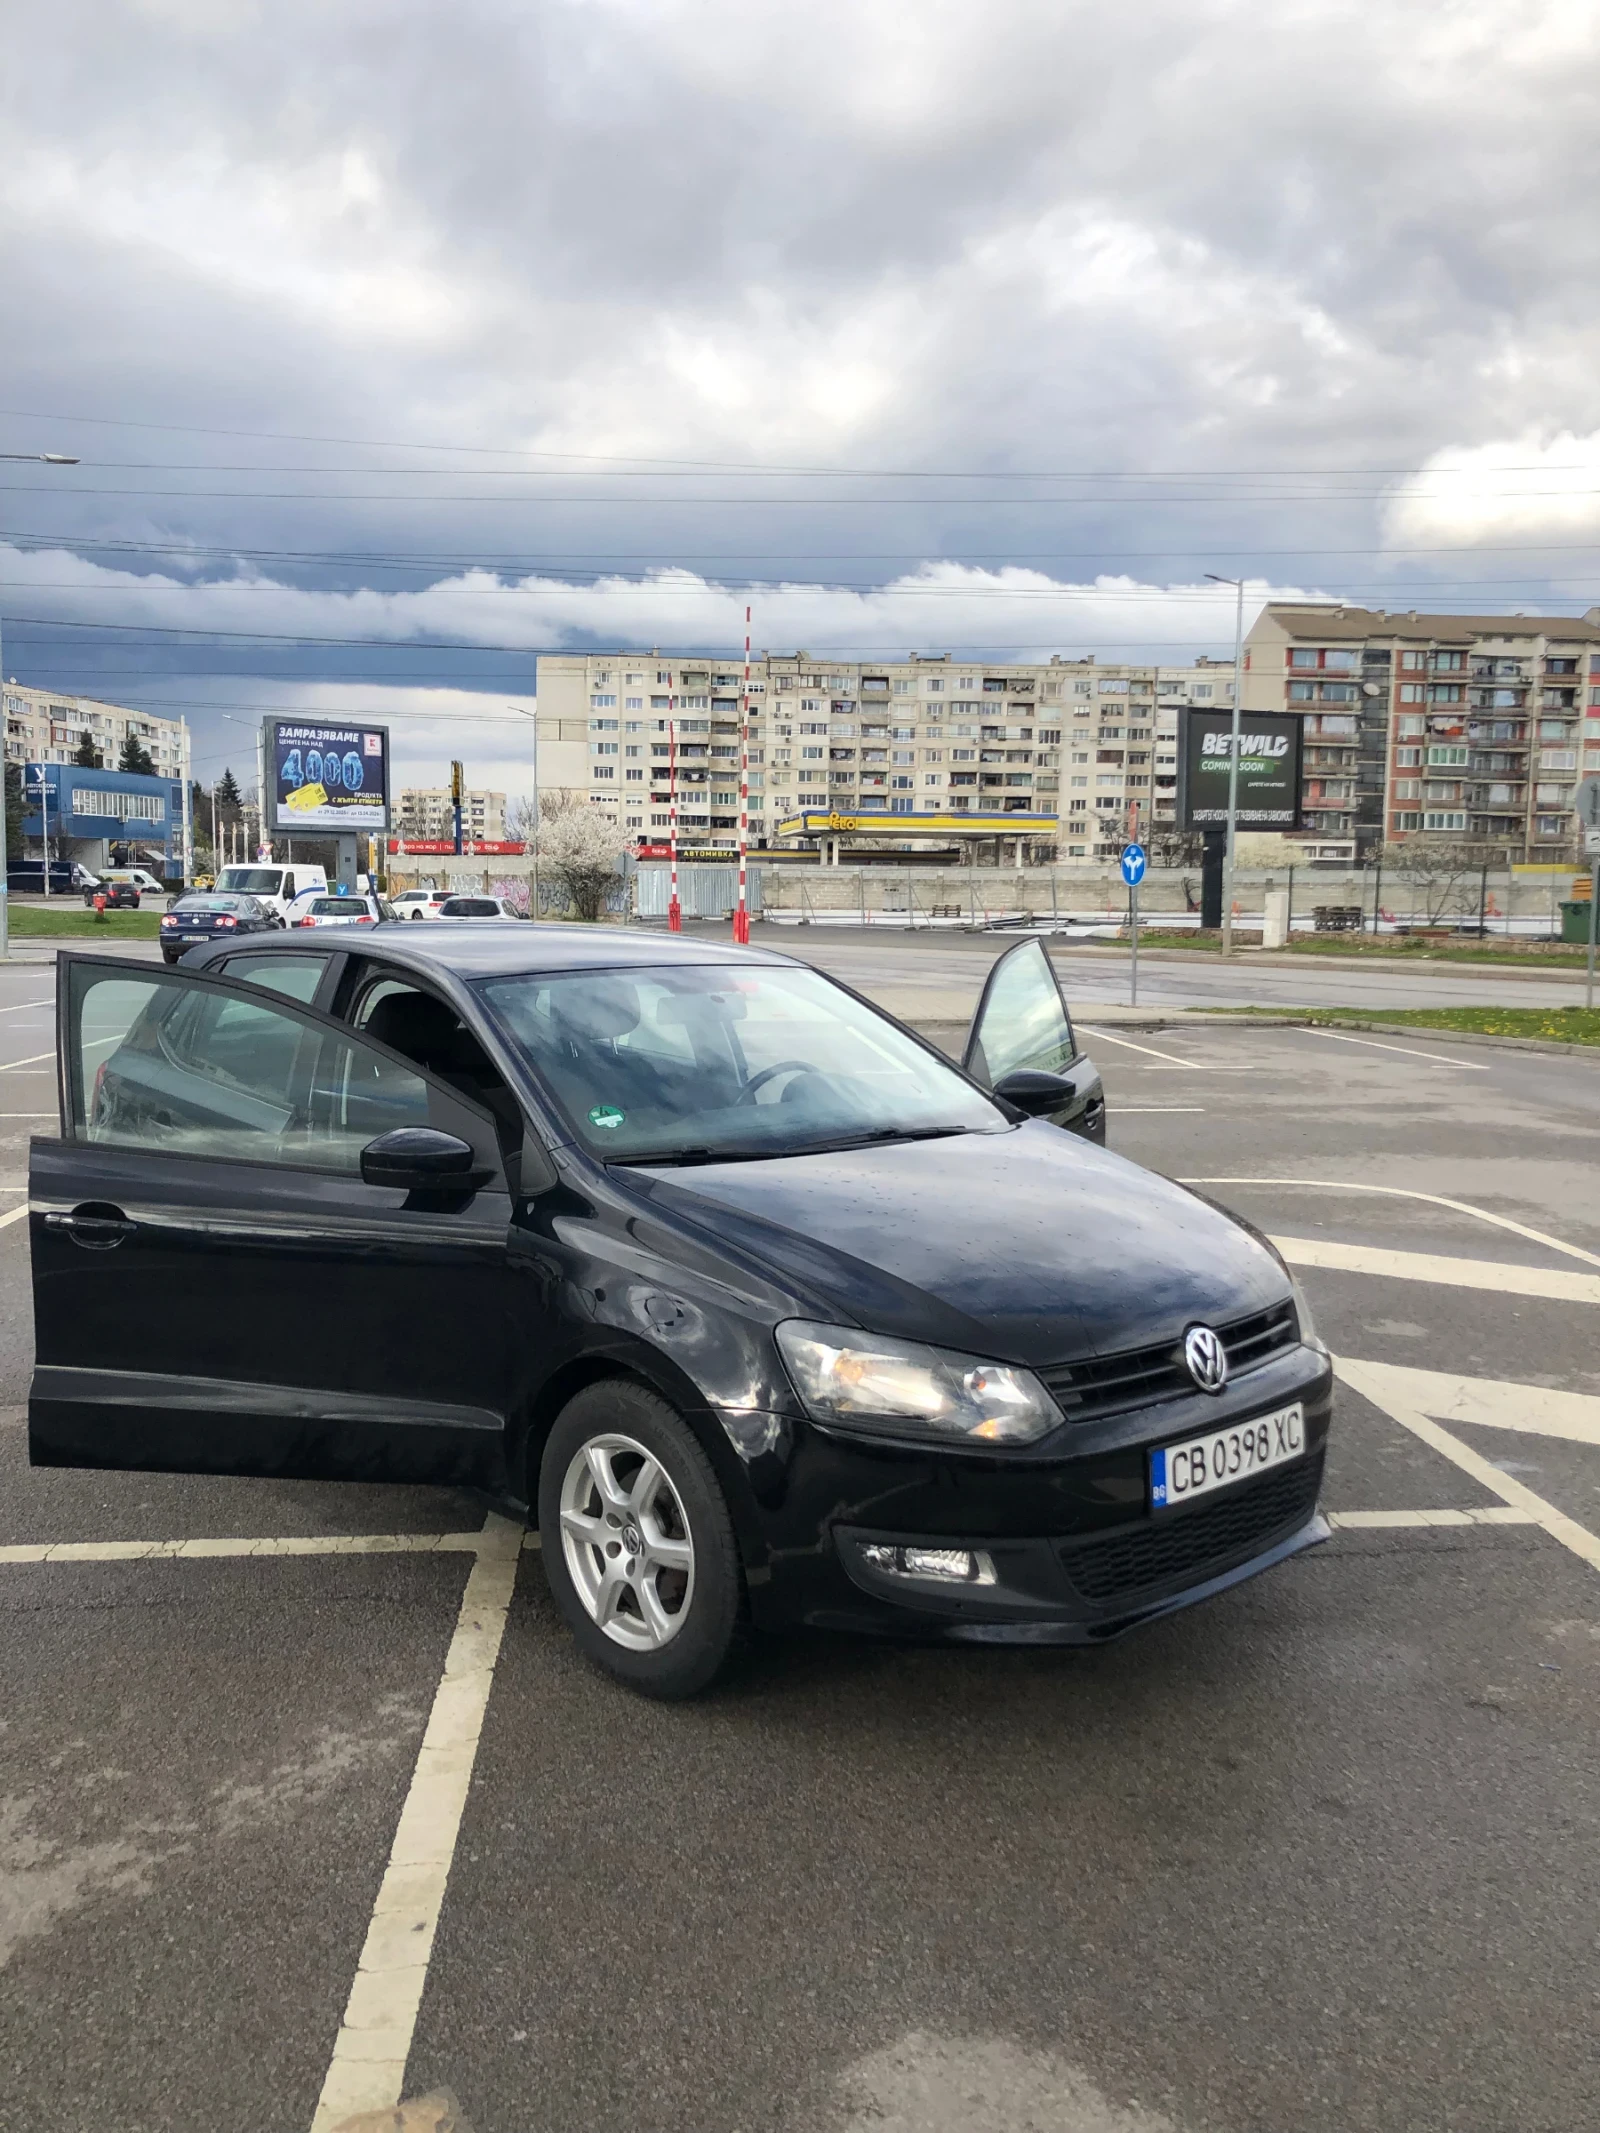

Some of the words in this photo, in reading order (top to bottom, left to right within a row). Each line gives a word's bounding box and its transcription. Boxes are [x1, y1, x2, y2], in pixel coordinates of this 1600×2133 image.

[279, 727, 359, 743] ЗАМРАЗЯВАМЕ
[311, 740, 324, 748] НАД
[281, 749, 364, 791] 4000
[1201, 761, 1232, 771] COMIN
[1238, 762, 1265, 772] SOON
[683, 850, 734, 858] АВТОМИВКА
[1172, 1444, 1206, 1493] CB
[1212, 1423, 1269, 1479] 0398
[1274, 1410, 1300, 1457] XC
[1153, 1484, 1166, 1500] BG
